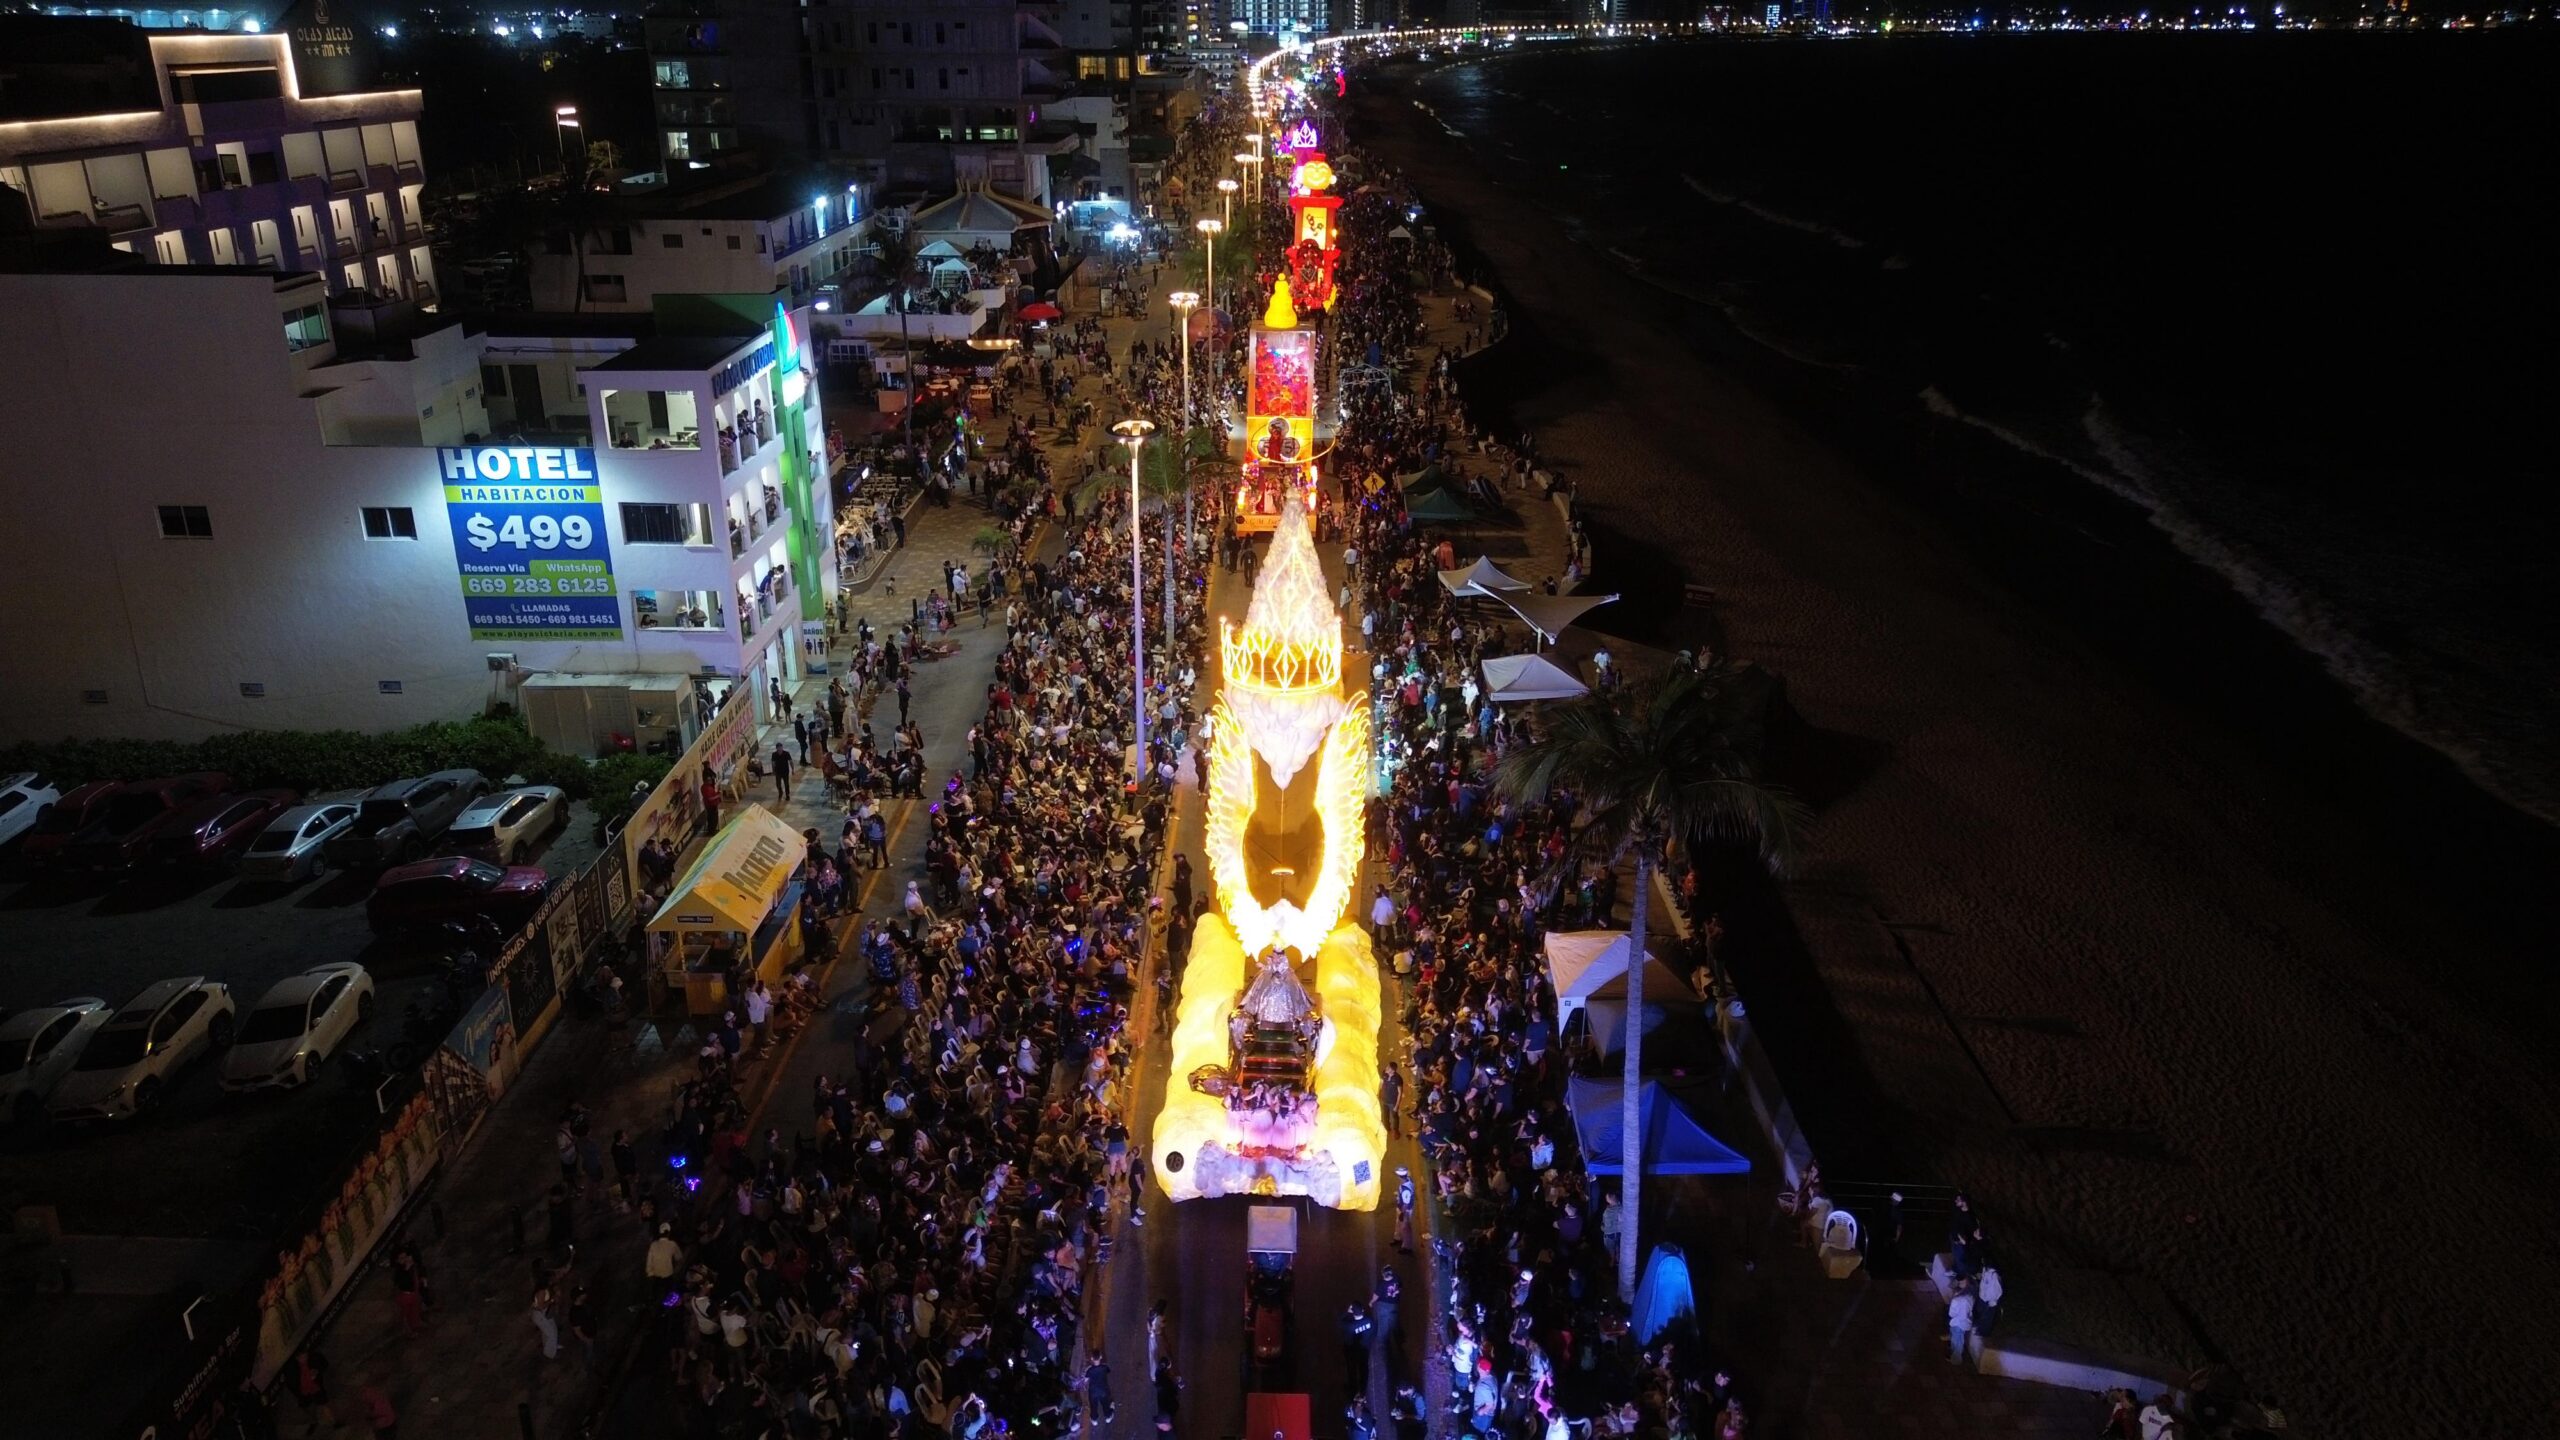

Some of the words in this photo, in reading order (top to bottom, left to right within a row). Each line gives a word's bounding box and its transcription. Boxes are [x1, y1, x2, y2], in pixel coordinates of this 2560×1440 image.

[326, 27, 353, 41] ALTAS
[441, 447, 593, 480] HOTEL
[461, 488, 586, 501] HABITACION
[466, 512, 593, 552] $499
[464, 563, 506, 573] Reserva
[508, 564, 526, 573] Via
[547, 562, 602, 574] WhatsApp
[468, 578, 507, 593] 669
[513, 578, 551, 593] 283
[557, 577, 609, 593] 6125
[522, 604, 571, 612] LLAMADAS
[474, 615, 493, 624] 669
[495, 615, 514, 624] 981
[569, 615, 588, 624] 981
[589, 615, 615, 624] 5451
[803, 627, 824, 636] BAÑOS
